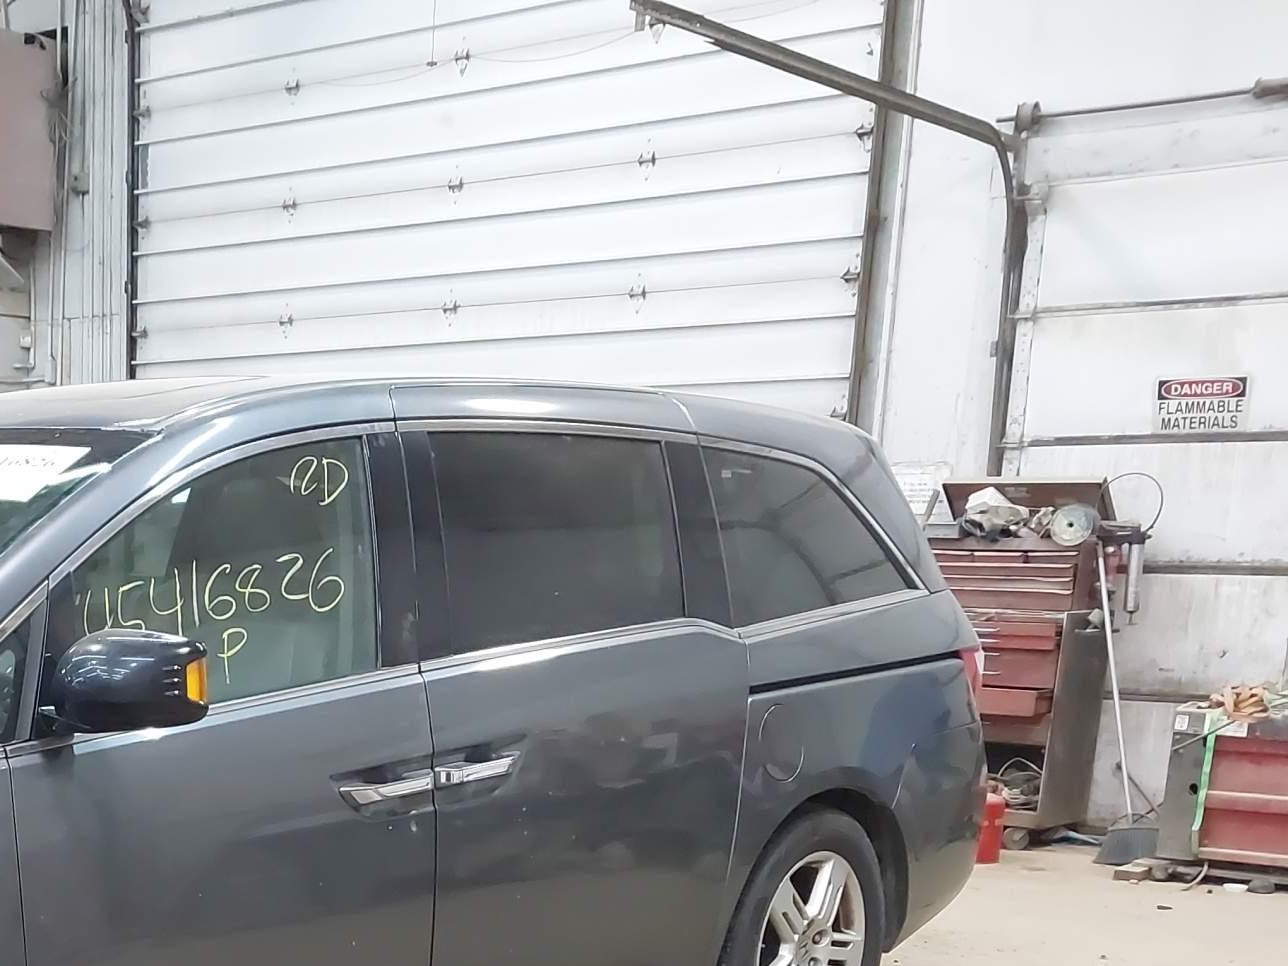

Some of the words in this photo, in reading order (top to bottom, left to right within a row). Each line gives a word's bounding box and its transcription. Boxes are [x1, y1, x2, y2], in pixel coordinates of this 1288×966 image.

[1171, 382, 1233, 395] DANGER
[1158, 399, 1244, 415] FLAMMABLE
[1160, 415, 1238, 431] MATERIALS
[217, 627, 247, 685] P
